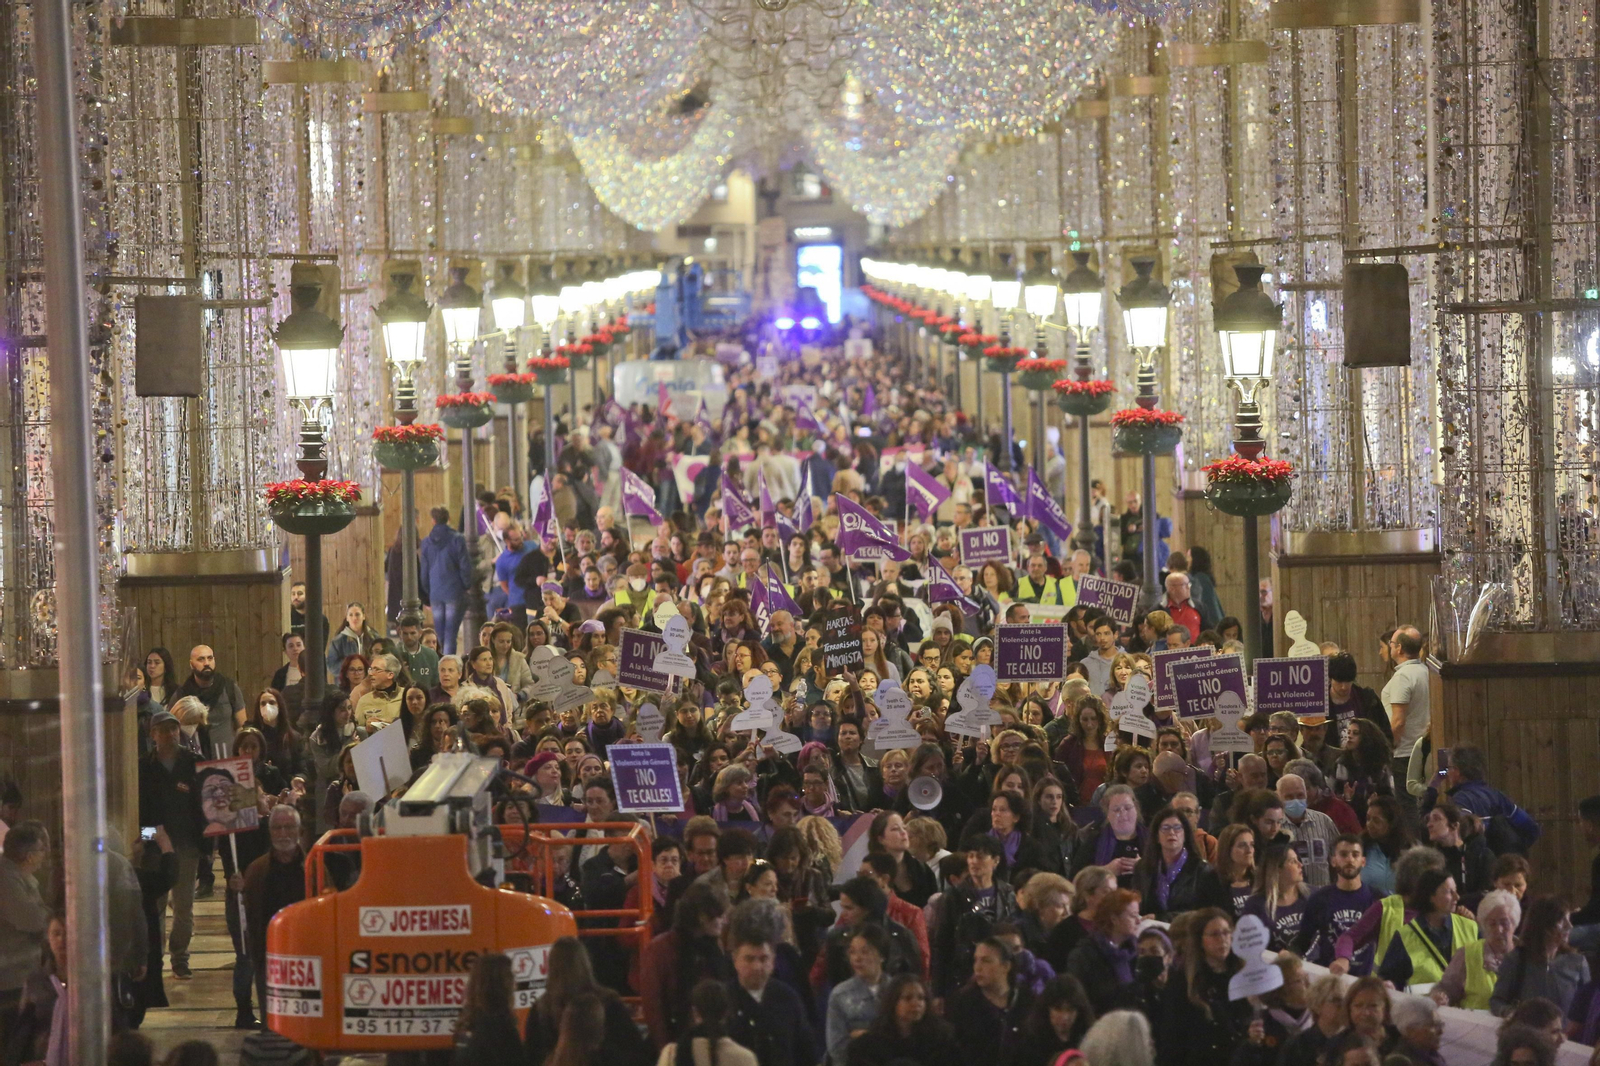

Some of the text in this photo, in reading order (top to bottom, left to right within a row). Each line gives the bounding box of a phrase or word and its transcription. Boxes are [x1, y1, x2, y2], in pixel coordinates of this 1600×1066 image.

[970, 532, 999, 548] DI NO
[867, 546, 882, 557] CALL
[1083, 578, 1133, 599] IGUALDAD
[1098, 593, 1114, 607] SIN
[826, 616, 854, 630] HARTAS
[838, 628, 847, 637] DE
[632, 642, 644, 658] DI
[621, 670, 641, 680] contra
[1006, 662, 1056, 675] TE CALLES!
[1176, 671, 1205, 680] Violencia
[1215, 667, 1238, 675] Género
[1270, 664, 1312, 686] DI NO
[1282, 690, 1314, 698] Violencia
[1187, 699, 1200, 712] TE
[1294, 700, 1324, 708] mujeres
[627, 788, 673, 804] TE CALLES!
[390, 908, 470, 932] JOFEMESA
[1333, 909, 1362, 922] JUNTA
[375, 948, 487, 974] snorke
[294, 1000, 309, 1014] 30
[356, 1020, 457, 1033] 95 117 37 3
